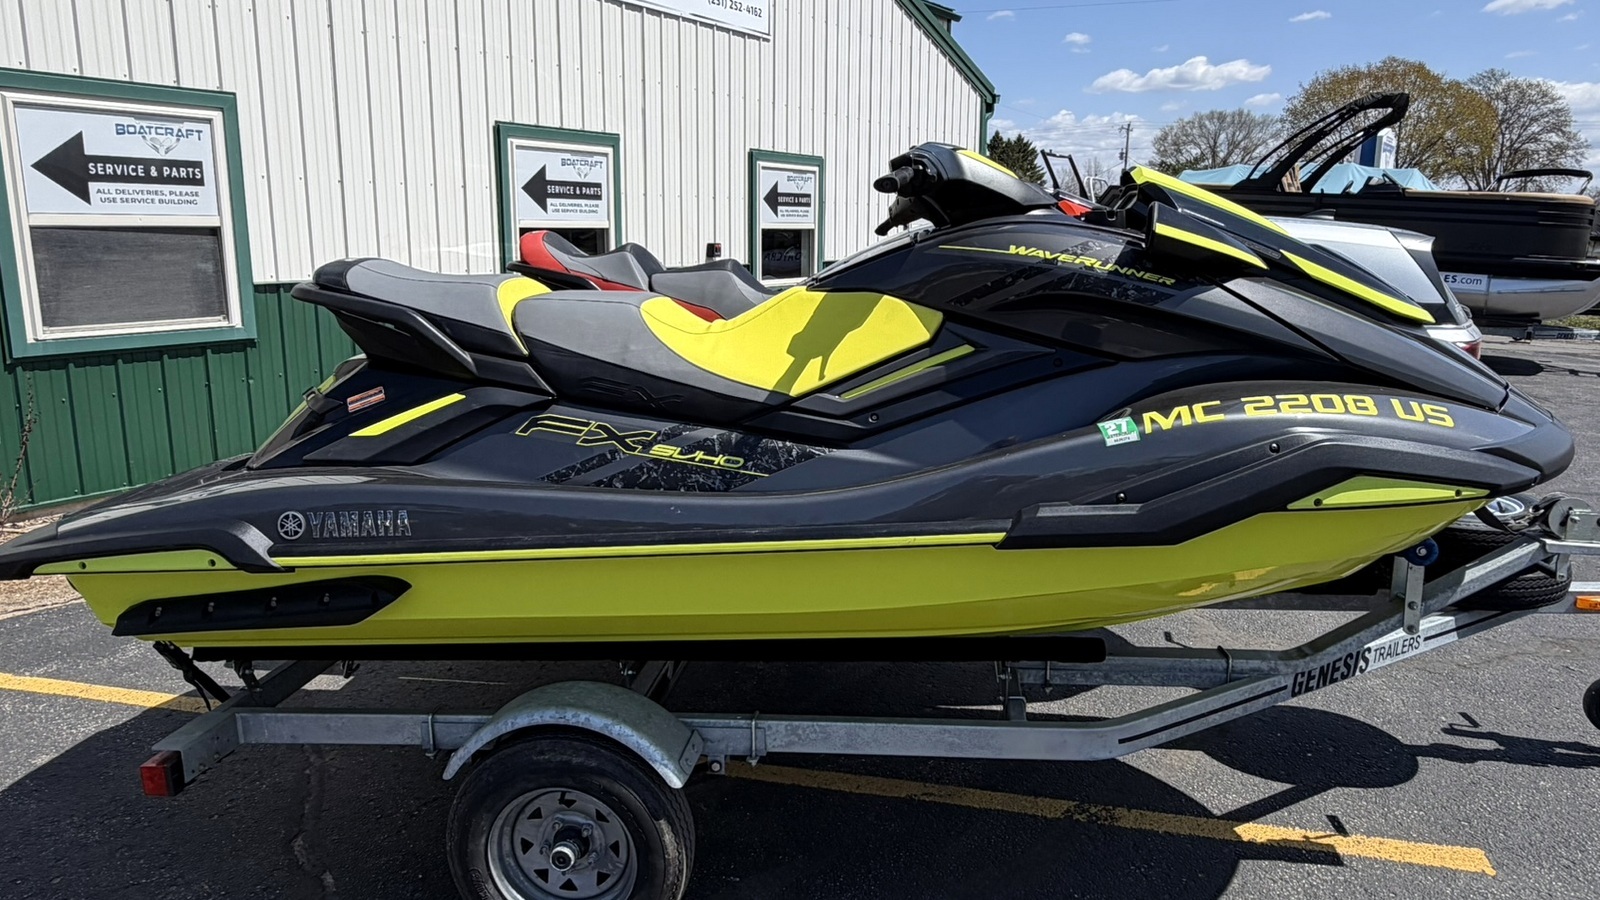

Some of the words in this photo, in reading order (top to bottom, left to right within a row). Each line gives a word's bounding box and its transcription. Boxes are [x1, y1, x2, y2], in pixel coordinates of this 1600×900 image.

[115, 123, 204, 141] BOATCRAFT
[88, 162, 146, 177] SERVICE
[149, 165, 158, 177] &
[162, 166, 202, 179] PARTS
[561, 158, 603, 169] BOATCRAFT
[115, 188, 168, 197] DELIVERIES,
[546, 184, 575, 195] SERVICE
[575, 186, 581, 195] &
[582, 187, 602, 196] PARTS
[119, 197, 156, 205] SERVICE
[158, 198, 198, 206] BUILDING
[1009, 244, 1176, 286] WAVERUNNER
[1142, 400, 1225, 435] MC
[1240, 393, 1379, 417] 2208
[1389, 398, 1455, 428] US
[515, 413, 657, 454] FX
[1104, 420, 1128, 435] 27
[306, 510, 412, 538] YAMAHA
[1291, 646, 1372, 698] GENESIS
[1373, 635, 1421, 663] TRAILERS
